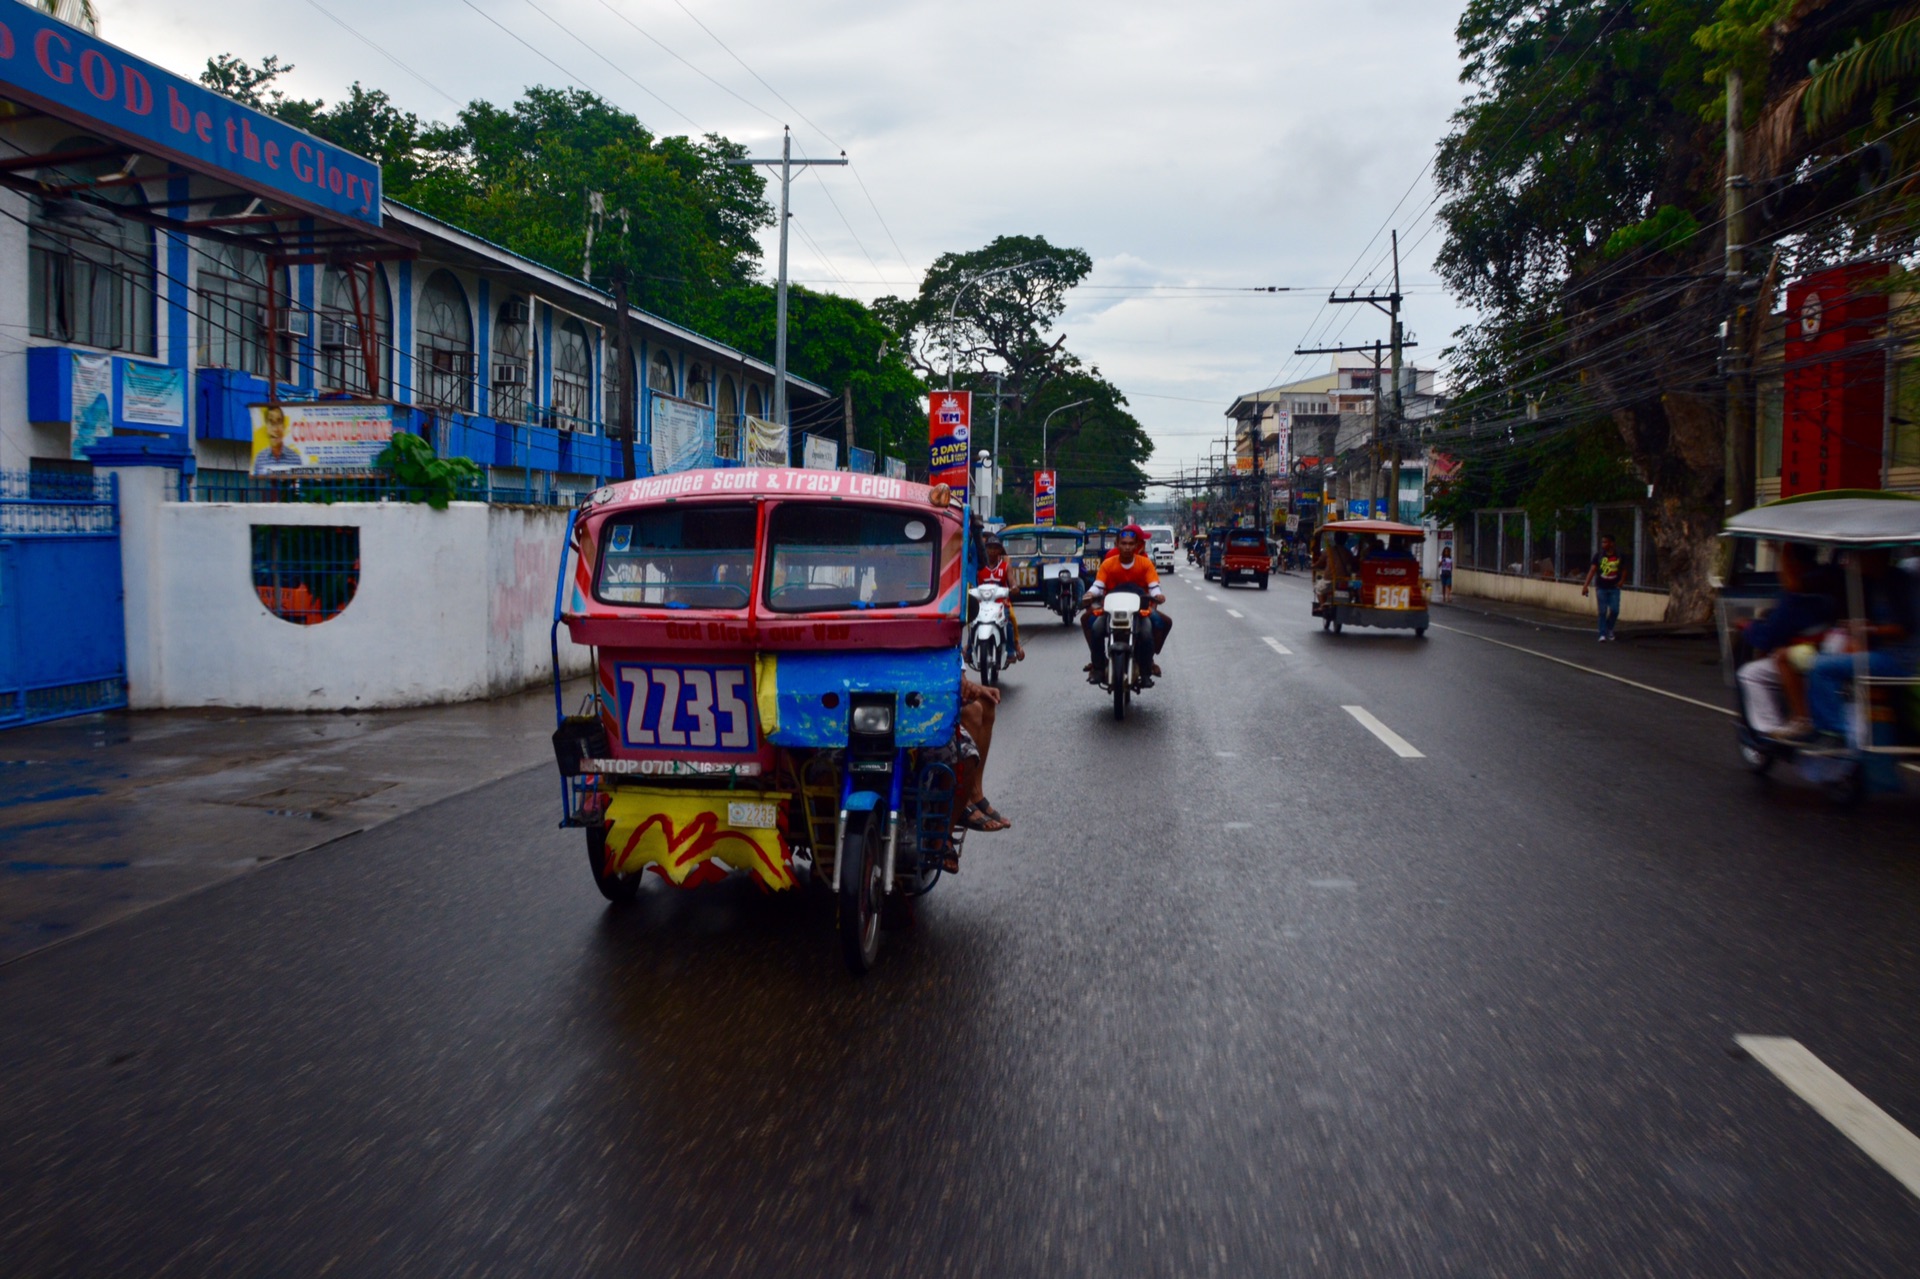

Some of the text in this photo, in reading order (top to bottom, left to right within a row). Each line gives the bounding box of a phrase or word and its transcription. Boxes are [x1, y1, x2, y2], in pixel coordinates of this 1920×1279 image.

[33, 28, 154, 116] GOD
[166, 84, 213, 144] be
[224, 117, 281, 171] the
[289, 141, 375, 215] Glory
[941, 413, 959, 422] TM
[931, 447, 938, 457] 2
[940, 441, 967, 455] DAYS
[931, 452, 955, 467] UNLI
[629, 471, 703, 501] Shandee
[711, 470, 759, 490] Scott
[766, 474, 780, 489] &
[785, 470, 840, 495] Tracy
[1375, 586, 1410, 609] 1364
[666, 621, 703, 642] God
[769, 626, 807, 642] our
[620, 666, 750, 748] 2235
[594, 758, 638, 774] MTOP
[746, 806, 775, 824] 2235
